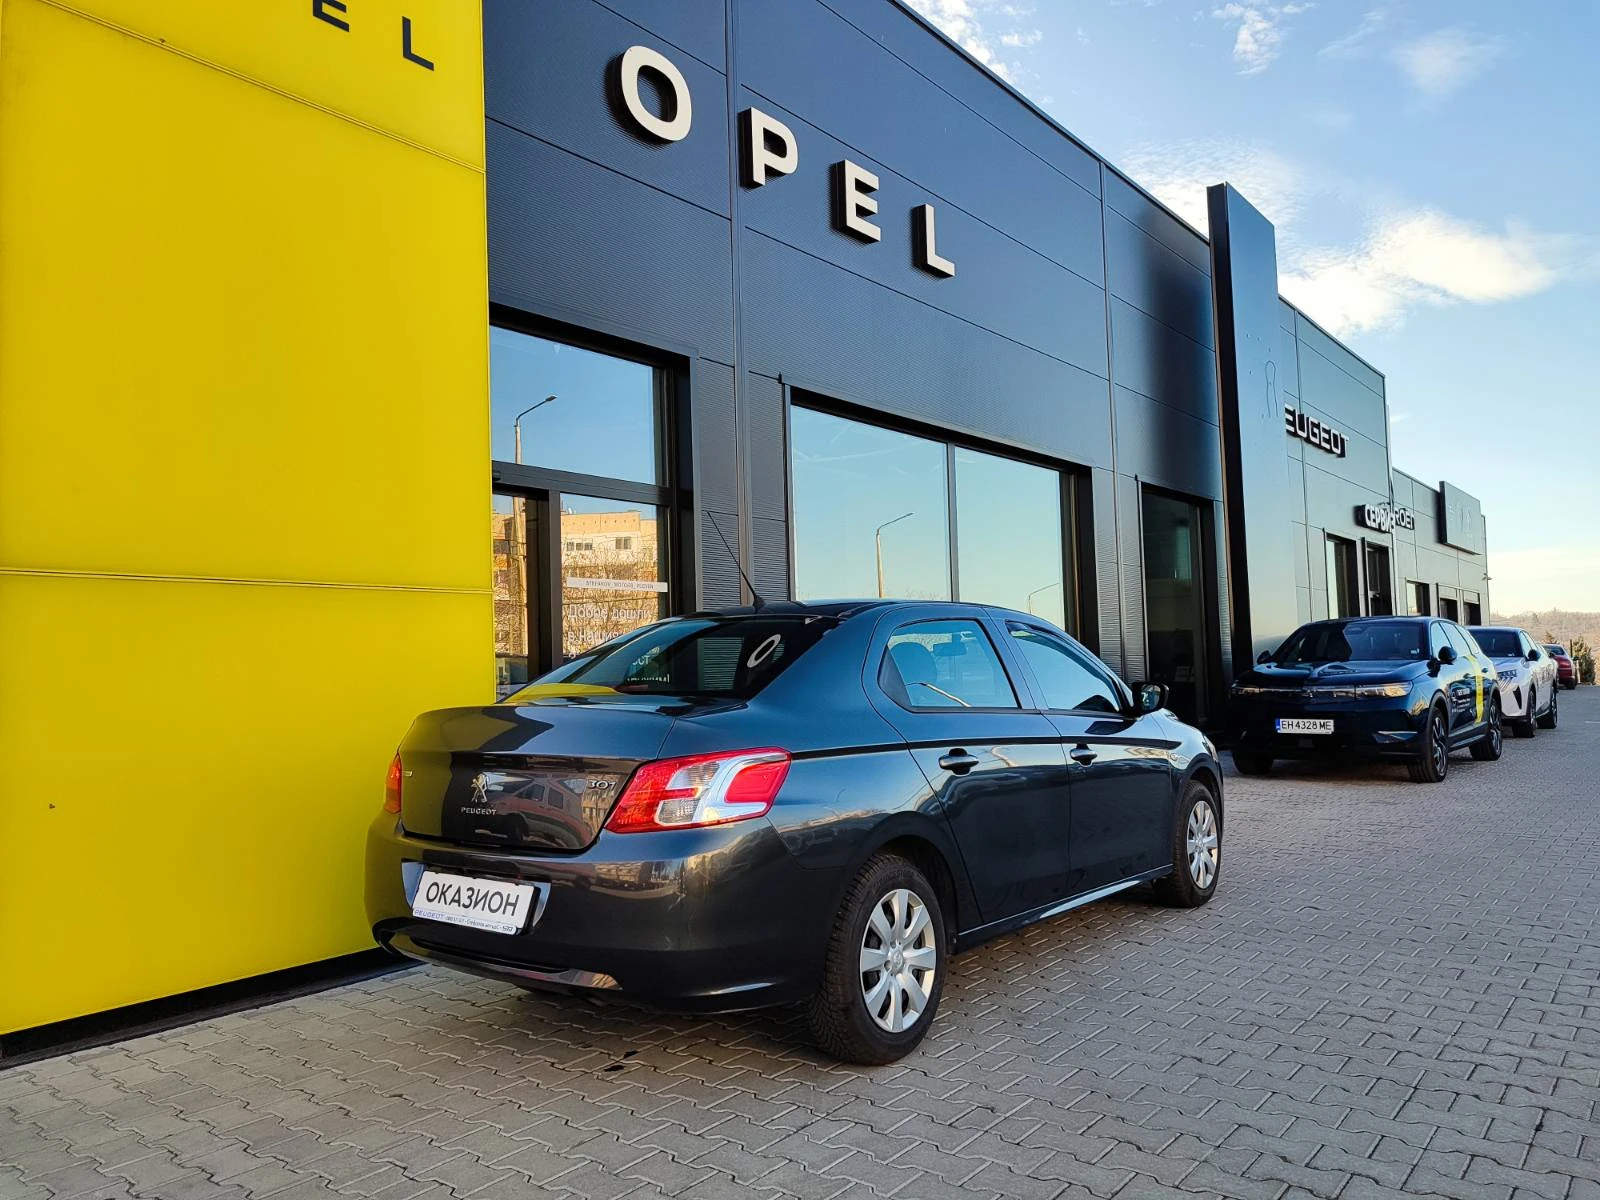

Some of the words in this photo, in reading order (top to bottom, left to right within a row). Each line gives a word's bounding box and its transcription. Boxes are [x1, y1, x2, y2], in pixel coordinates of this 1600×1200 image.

[614, 45, 956, 278] OPEL
[1295, 720, 1318, 730] 4328
[1319, 720, 1332, 731] ME
[460, 807, 497, 816] PEUGEOT
[425, 881, 520, 917] ОКАЗИОН
